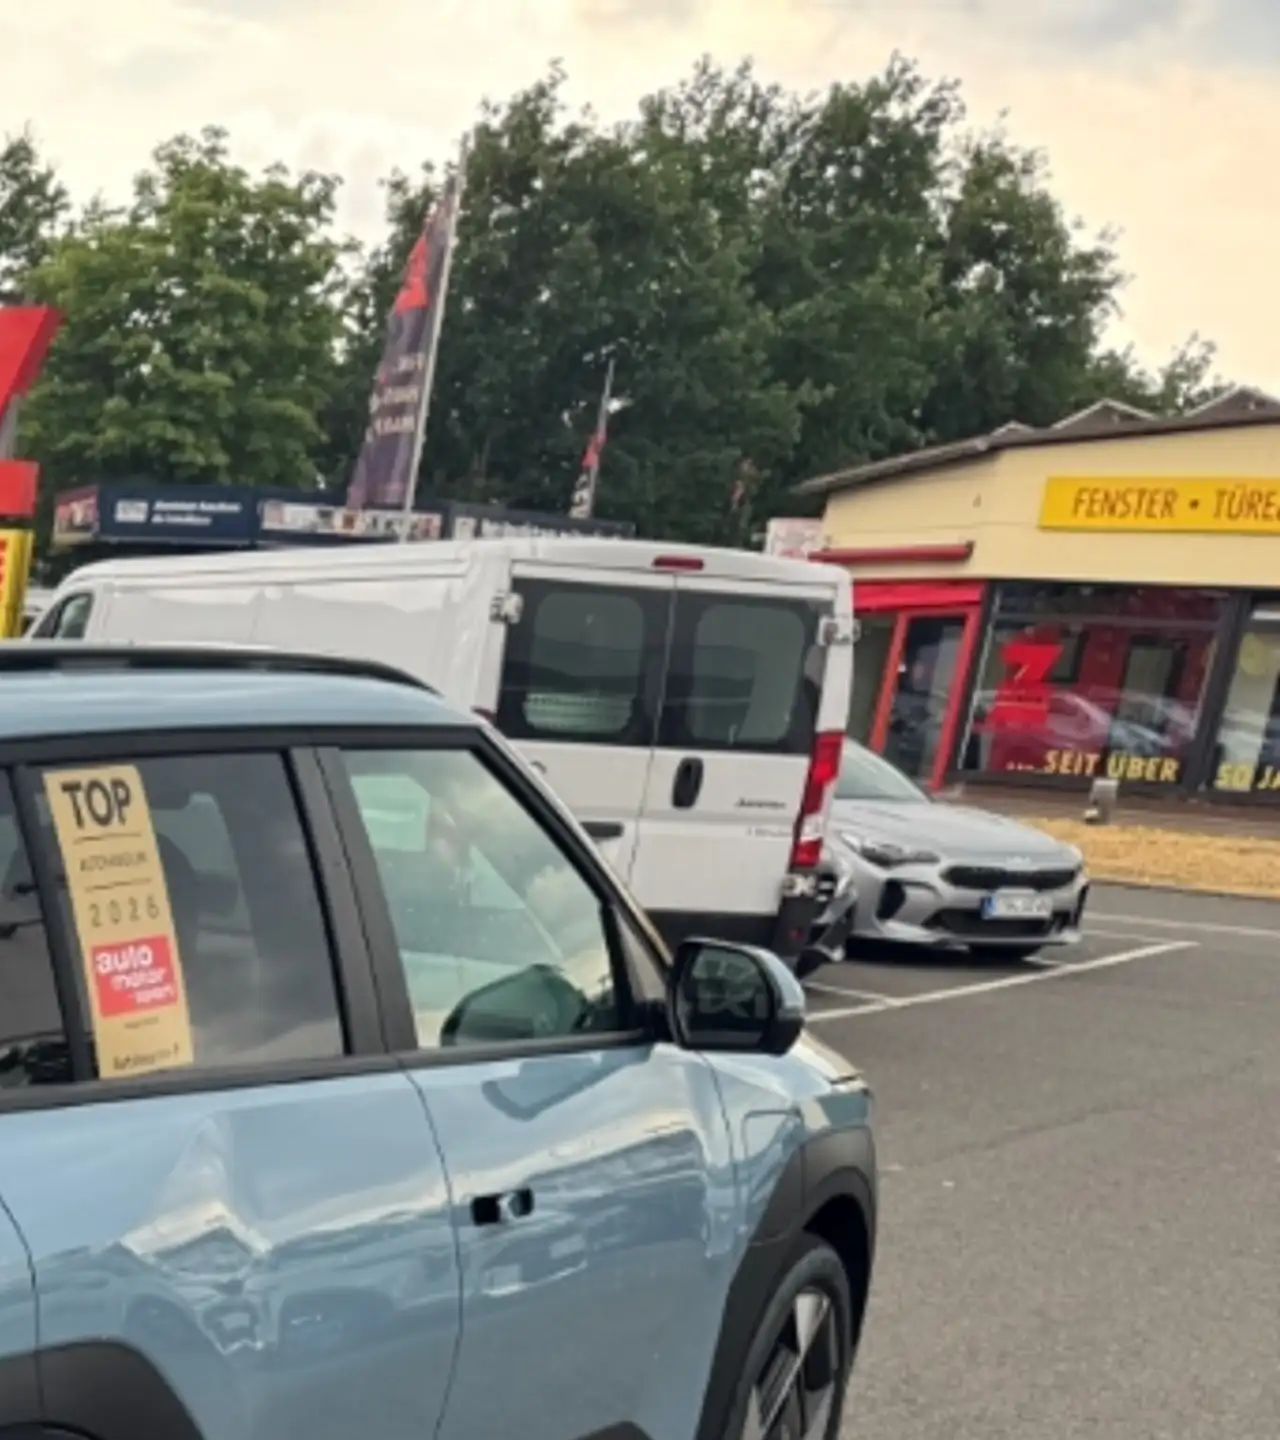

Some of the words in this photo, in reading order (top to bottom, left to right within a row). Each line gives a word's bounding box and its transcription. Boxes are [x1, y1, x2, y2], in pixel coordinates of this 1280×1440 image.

[1072, 486, 1179, 520] FENSTER
[1213, 483, 1280, 522] TÜRE
[1043, 749, 1100, 777] SEIT
[61, 777, 131, 830] TOP
[88, 893, 160, 928] 2026
[96, 944, 153, 974] auto
